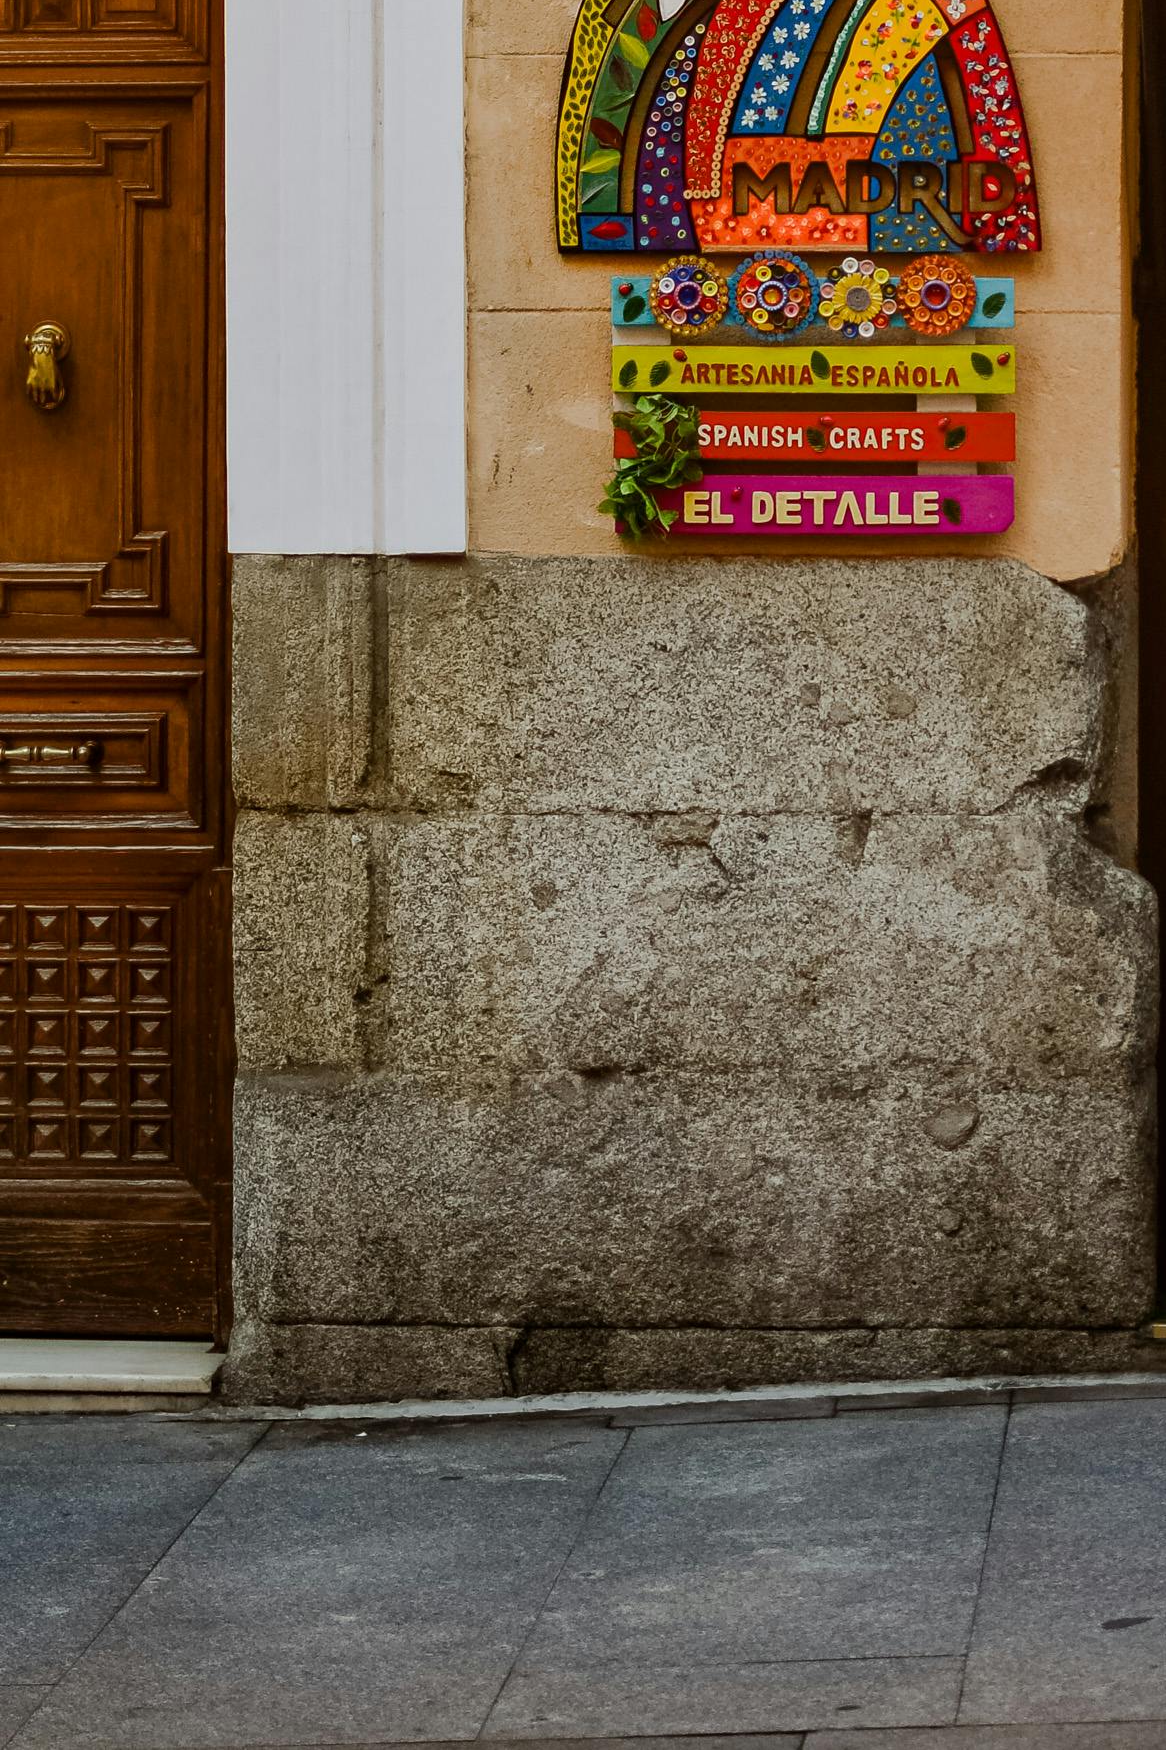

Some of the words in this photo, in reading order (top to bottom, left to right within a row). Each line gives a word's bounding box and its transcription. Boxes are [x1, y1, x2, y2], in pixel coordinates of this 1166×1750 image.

[731, 159, 1016, 245] MADRID
[680, 362, 814, 386] ARTESANIA
[829, 360, 960, 388] ESPAÑOLA
[697, 423, 803, 449] SPANISH
[828, 426, 925, 451] CRAFTS
[683, 490, 734, 525] EL
[751, 490, 940, 526] DETALLE
